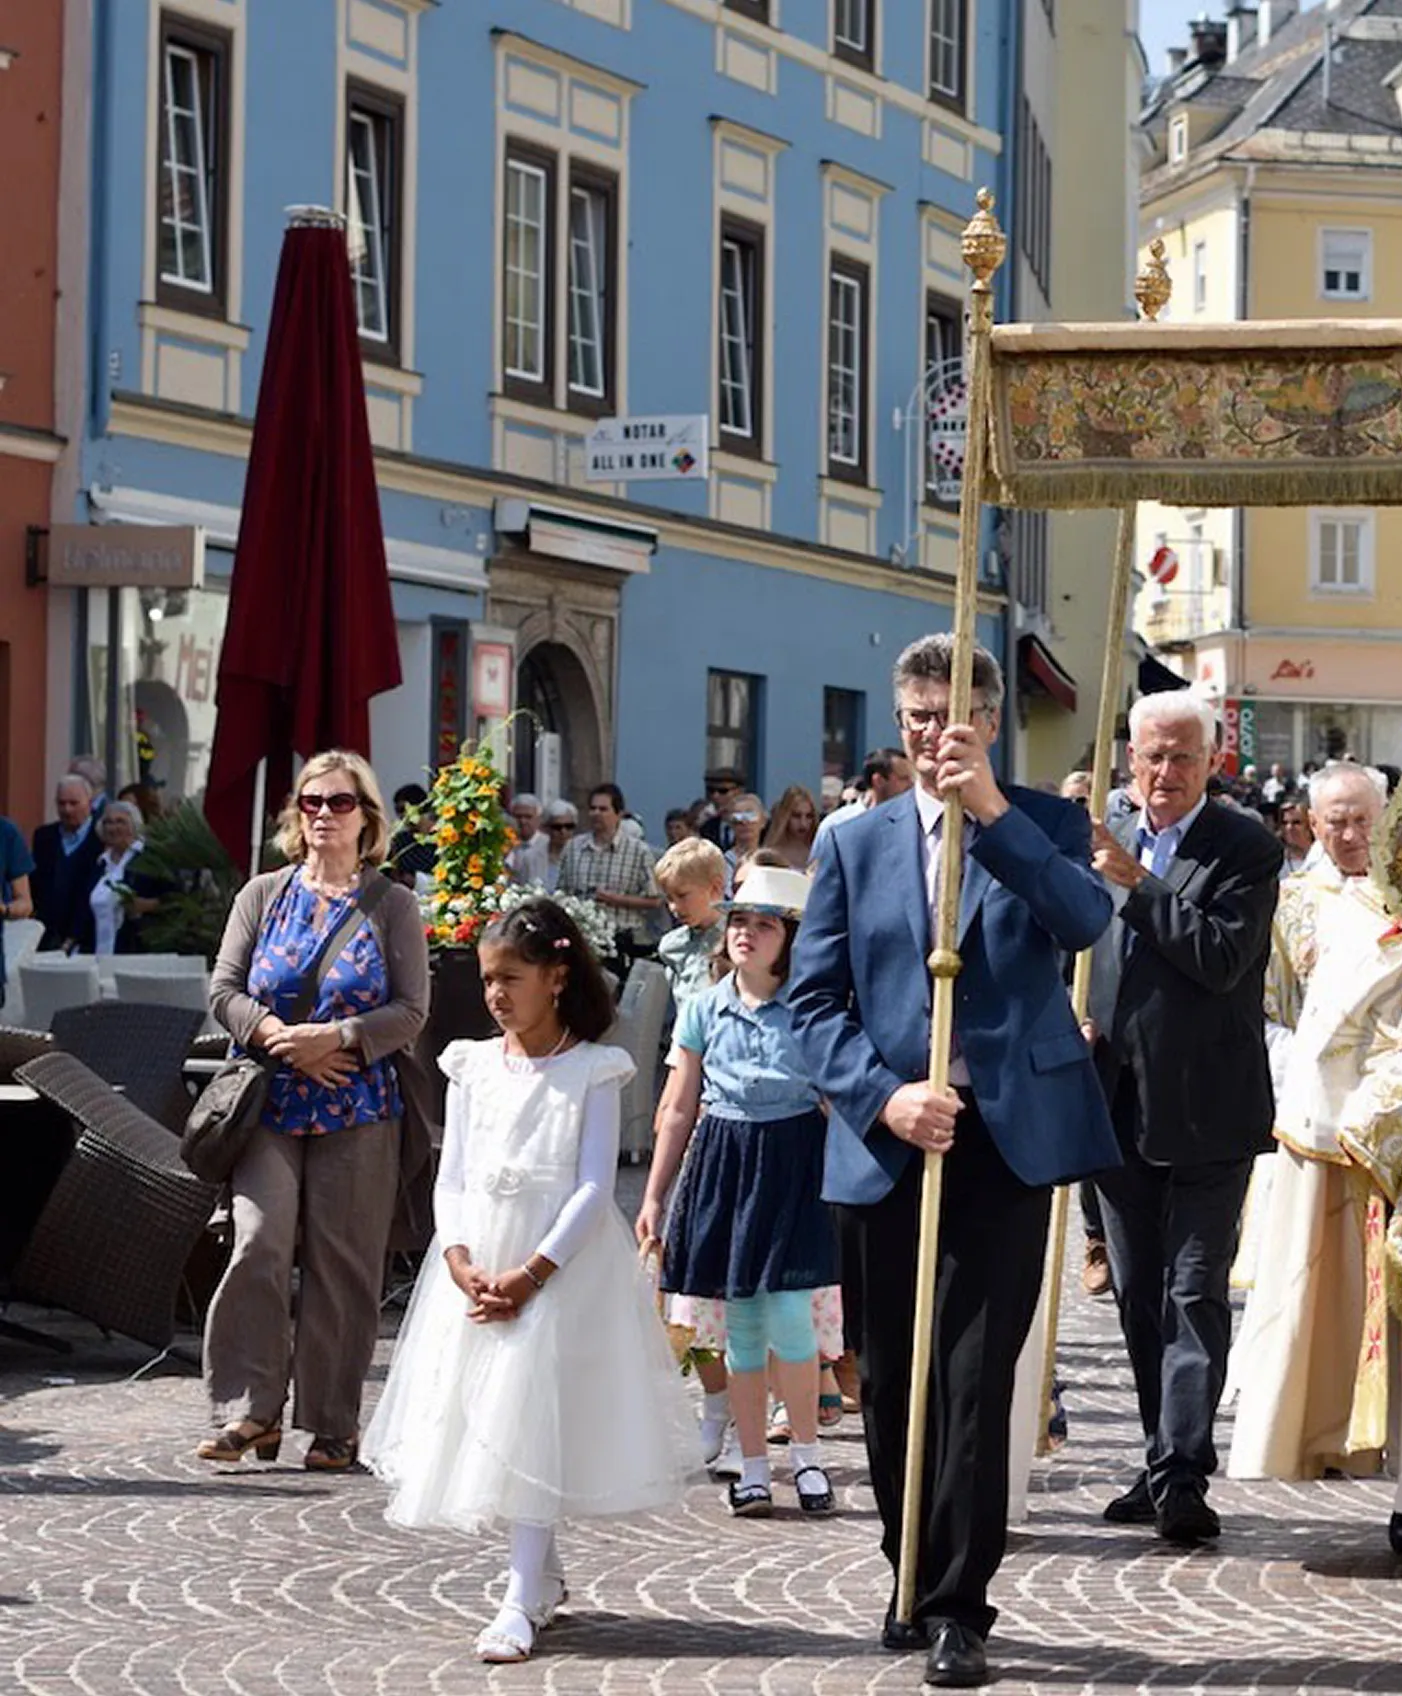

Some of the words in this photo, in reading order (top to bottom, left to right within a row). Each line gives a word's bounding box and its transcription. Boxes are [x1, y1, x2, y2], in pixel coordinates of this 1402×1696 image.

[623, 423, 666, 440] NOTAR
[592, 453, 615, 470] ALL
[620, 452, 634, 469] IN
[640, 451, 666, 469] ONE
